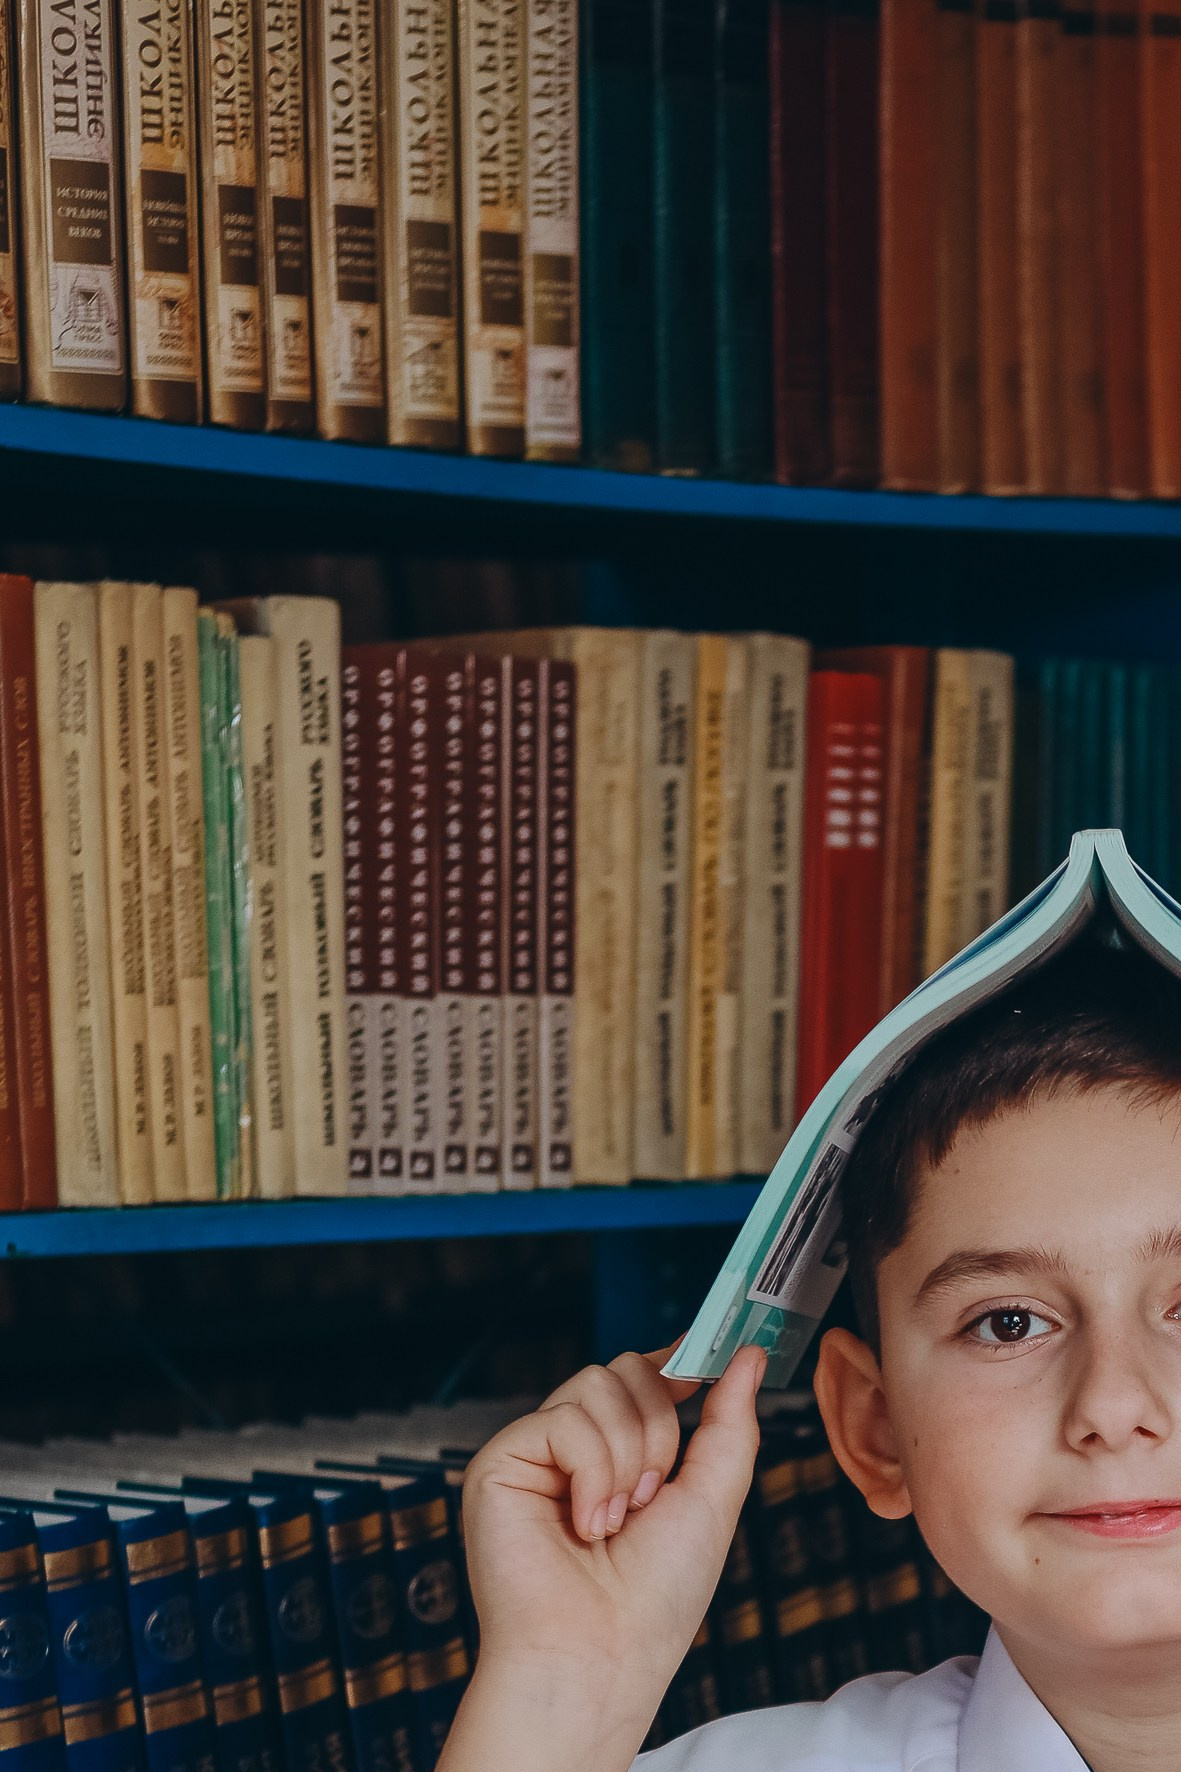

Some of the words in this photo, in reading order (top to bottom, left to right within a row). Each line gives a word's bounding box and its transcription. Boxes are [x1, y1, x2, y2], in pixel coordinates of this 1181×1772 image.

[51, 0, 81, 135] ШКОЛ
[83, 0, 109, 139] ЭНЦИКЛ
[138, 0, 164, 144] ШКОЛ
